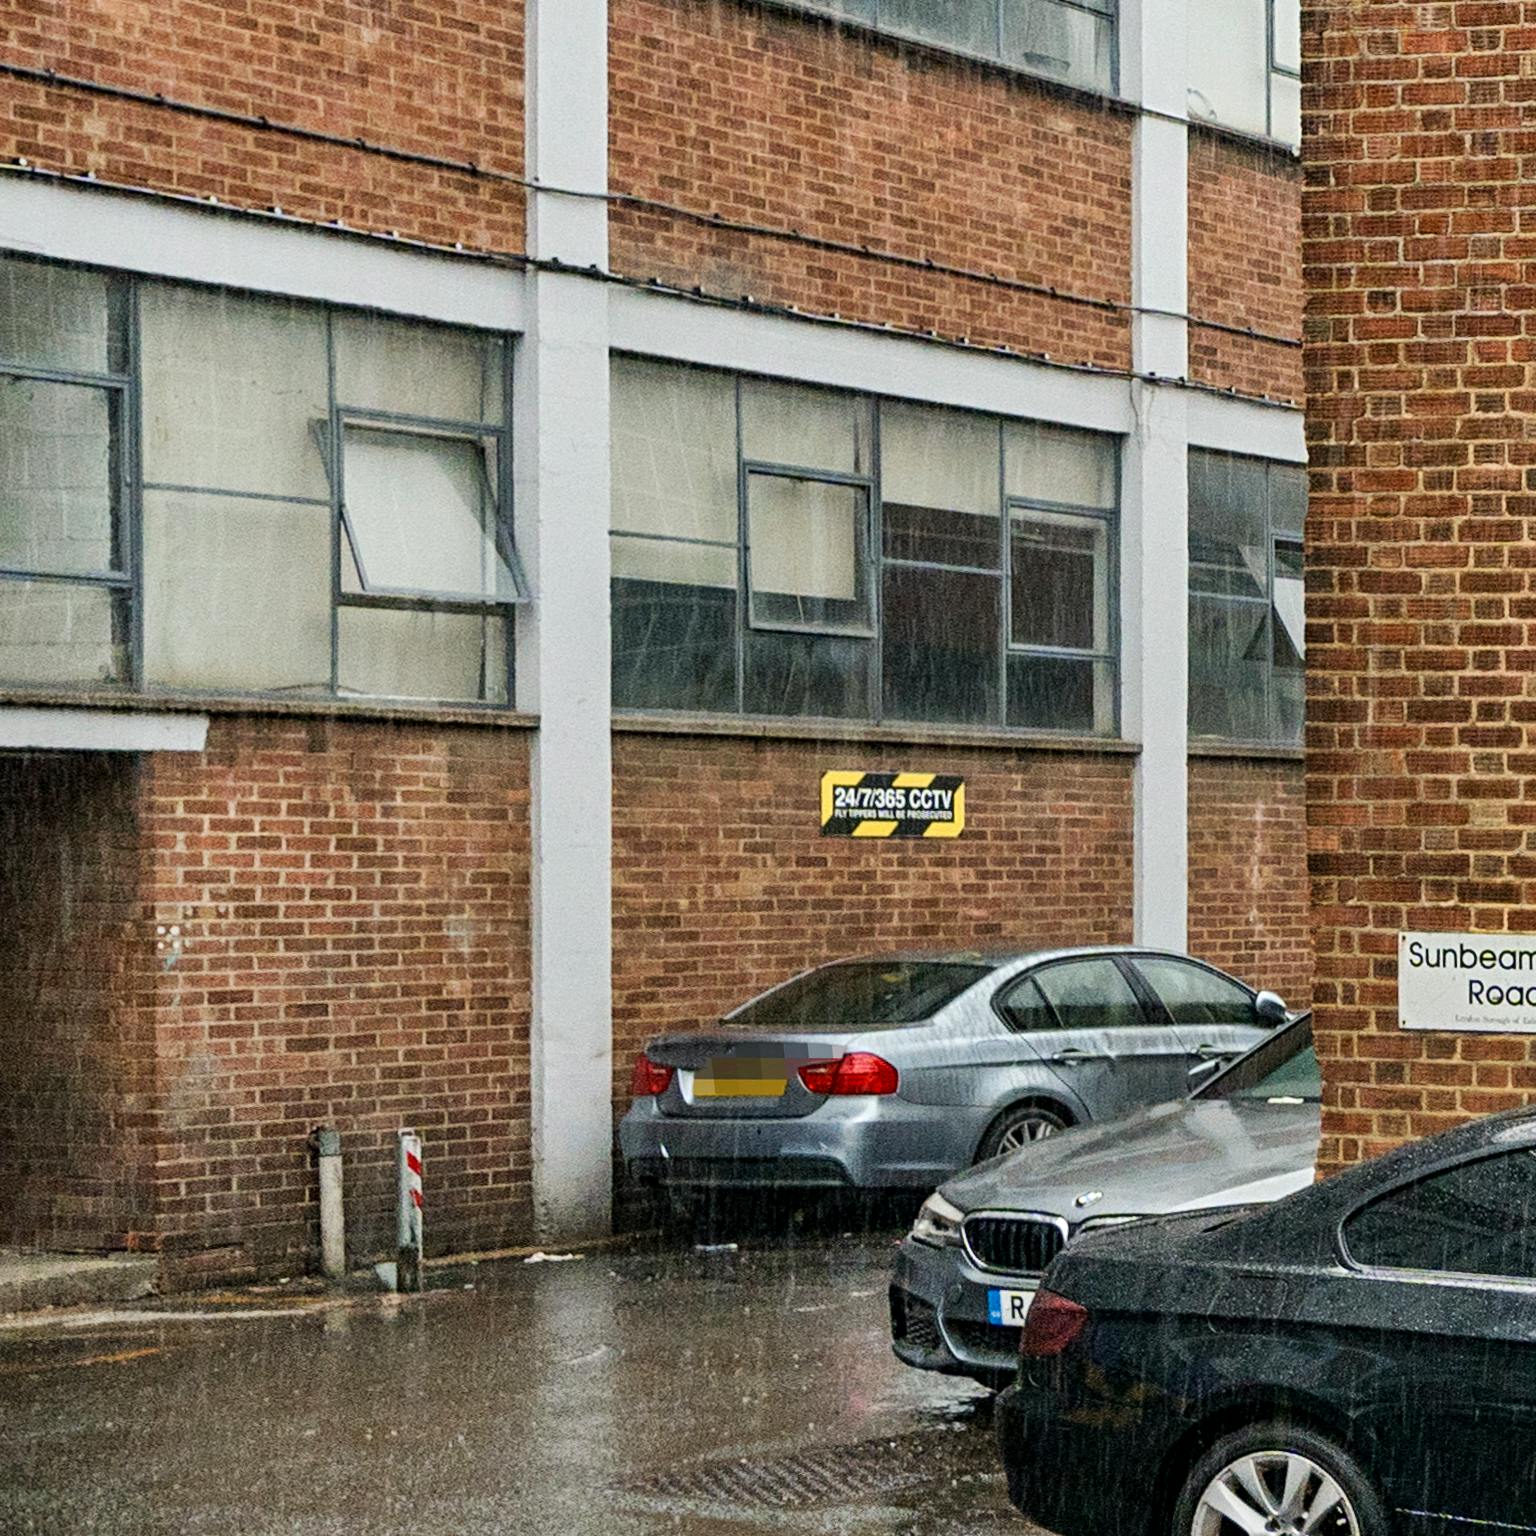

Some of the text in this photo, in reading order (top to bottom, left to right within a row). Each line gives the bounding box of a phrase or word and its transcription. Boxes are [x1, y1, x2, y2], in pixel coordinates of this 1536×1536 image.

[834, 787, 952, 810] 24/7/365 CCTV
[1010, 1295, 1024, 1319] R
